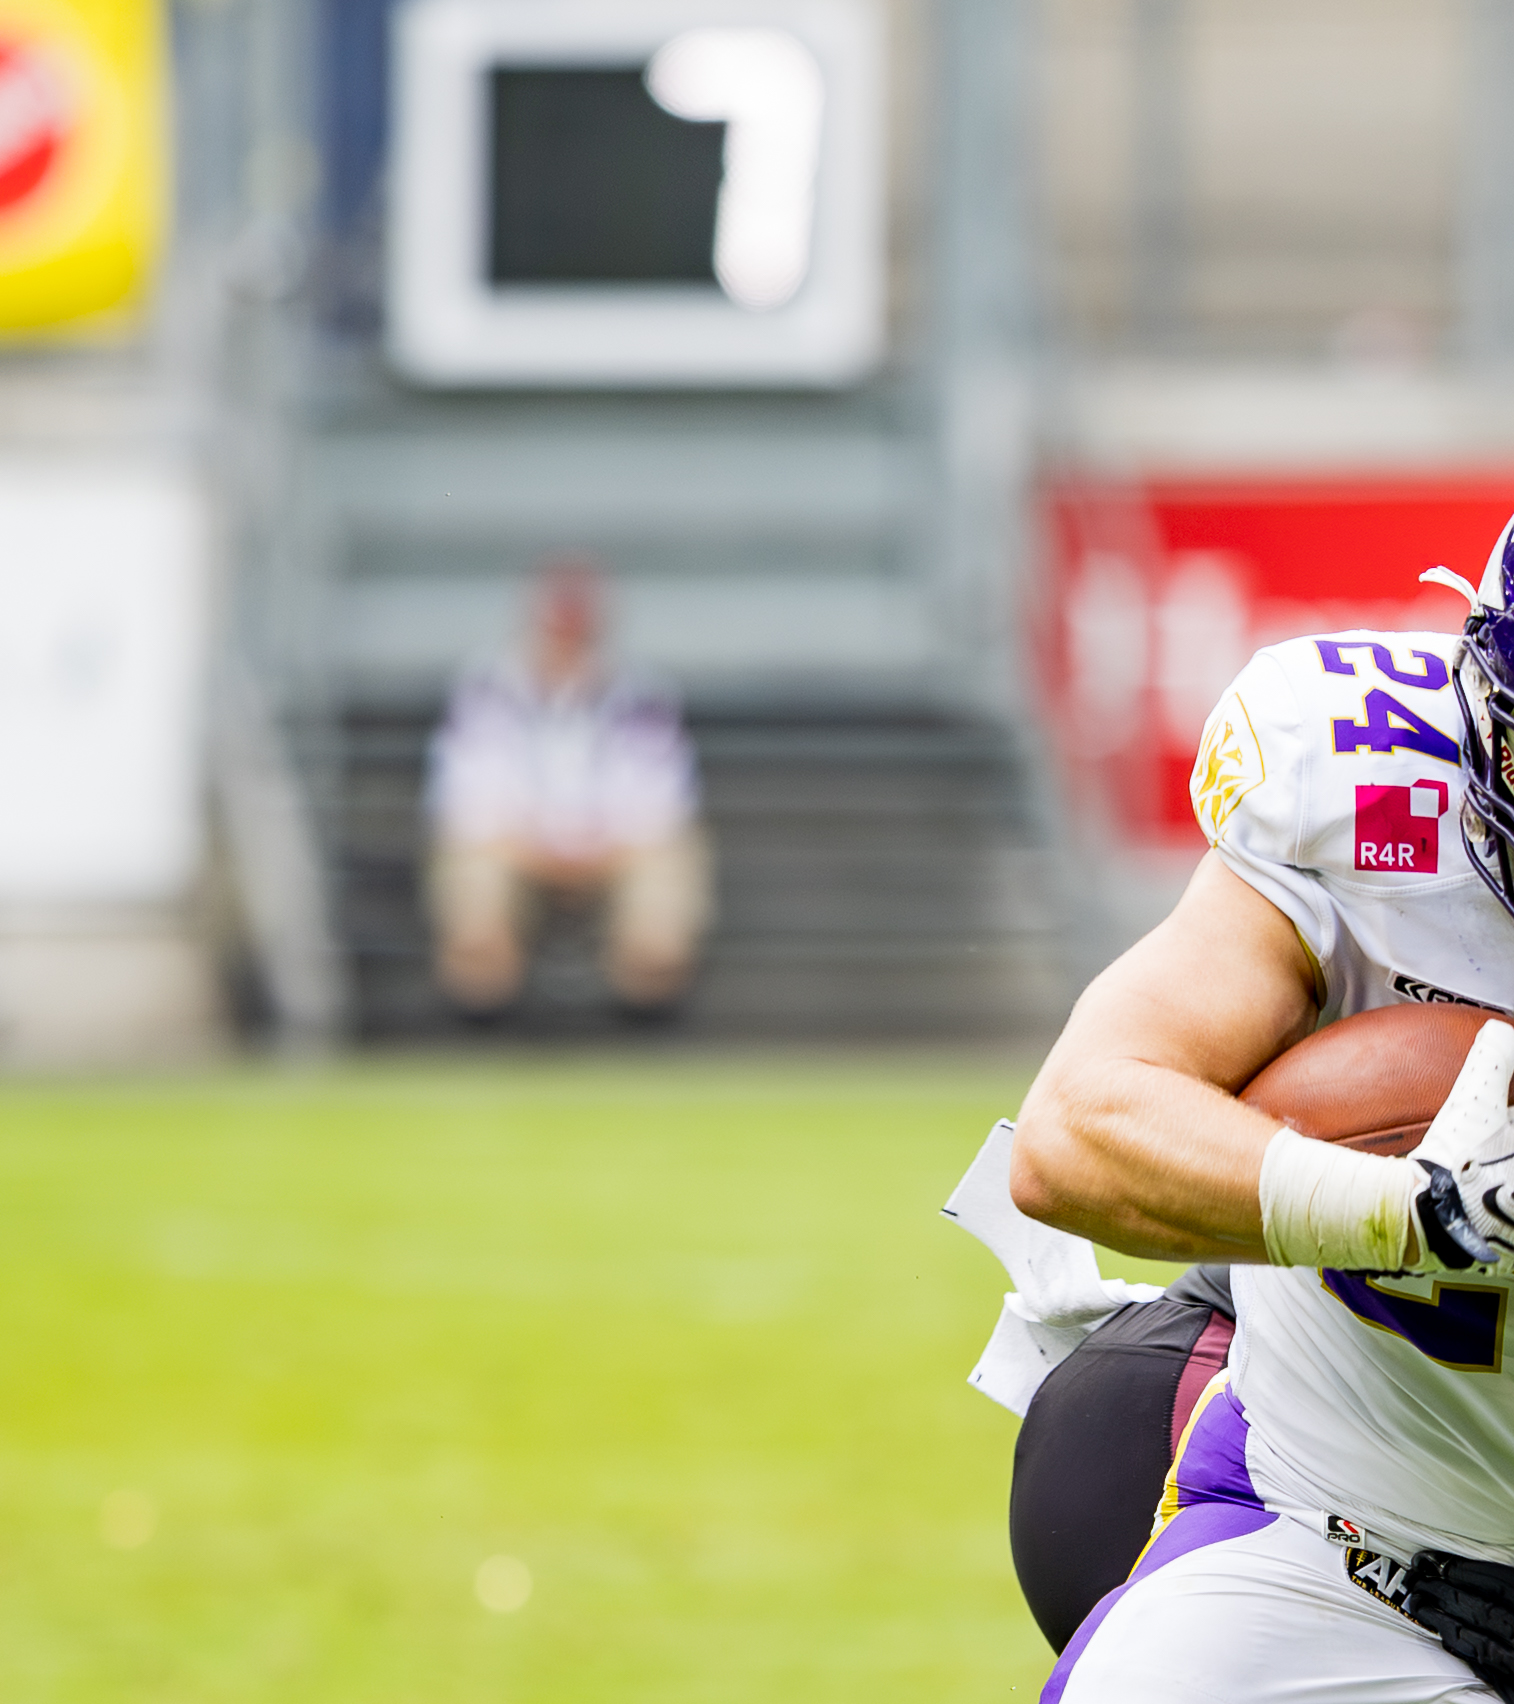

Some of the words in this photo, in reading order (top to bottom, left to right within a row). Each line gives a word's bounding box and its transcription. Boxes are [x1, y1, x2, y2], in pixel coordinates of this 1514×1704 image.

[1311, 640, 1462, 768] 24
[1360, 841, 1415, 867] R4R
[1327, 1532, 1361, 1544] PRO
